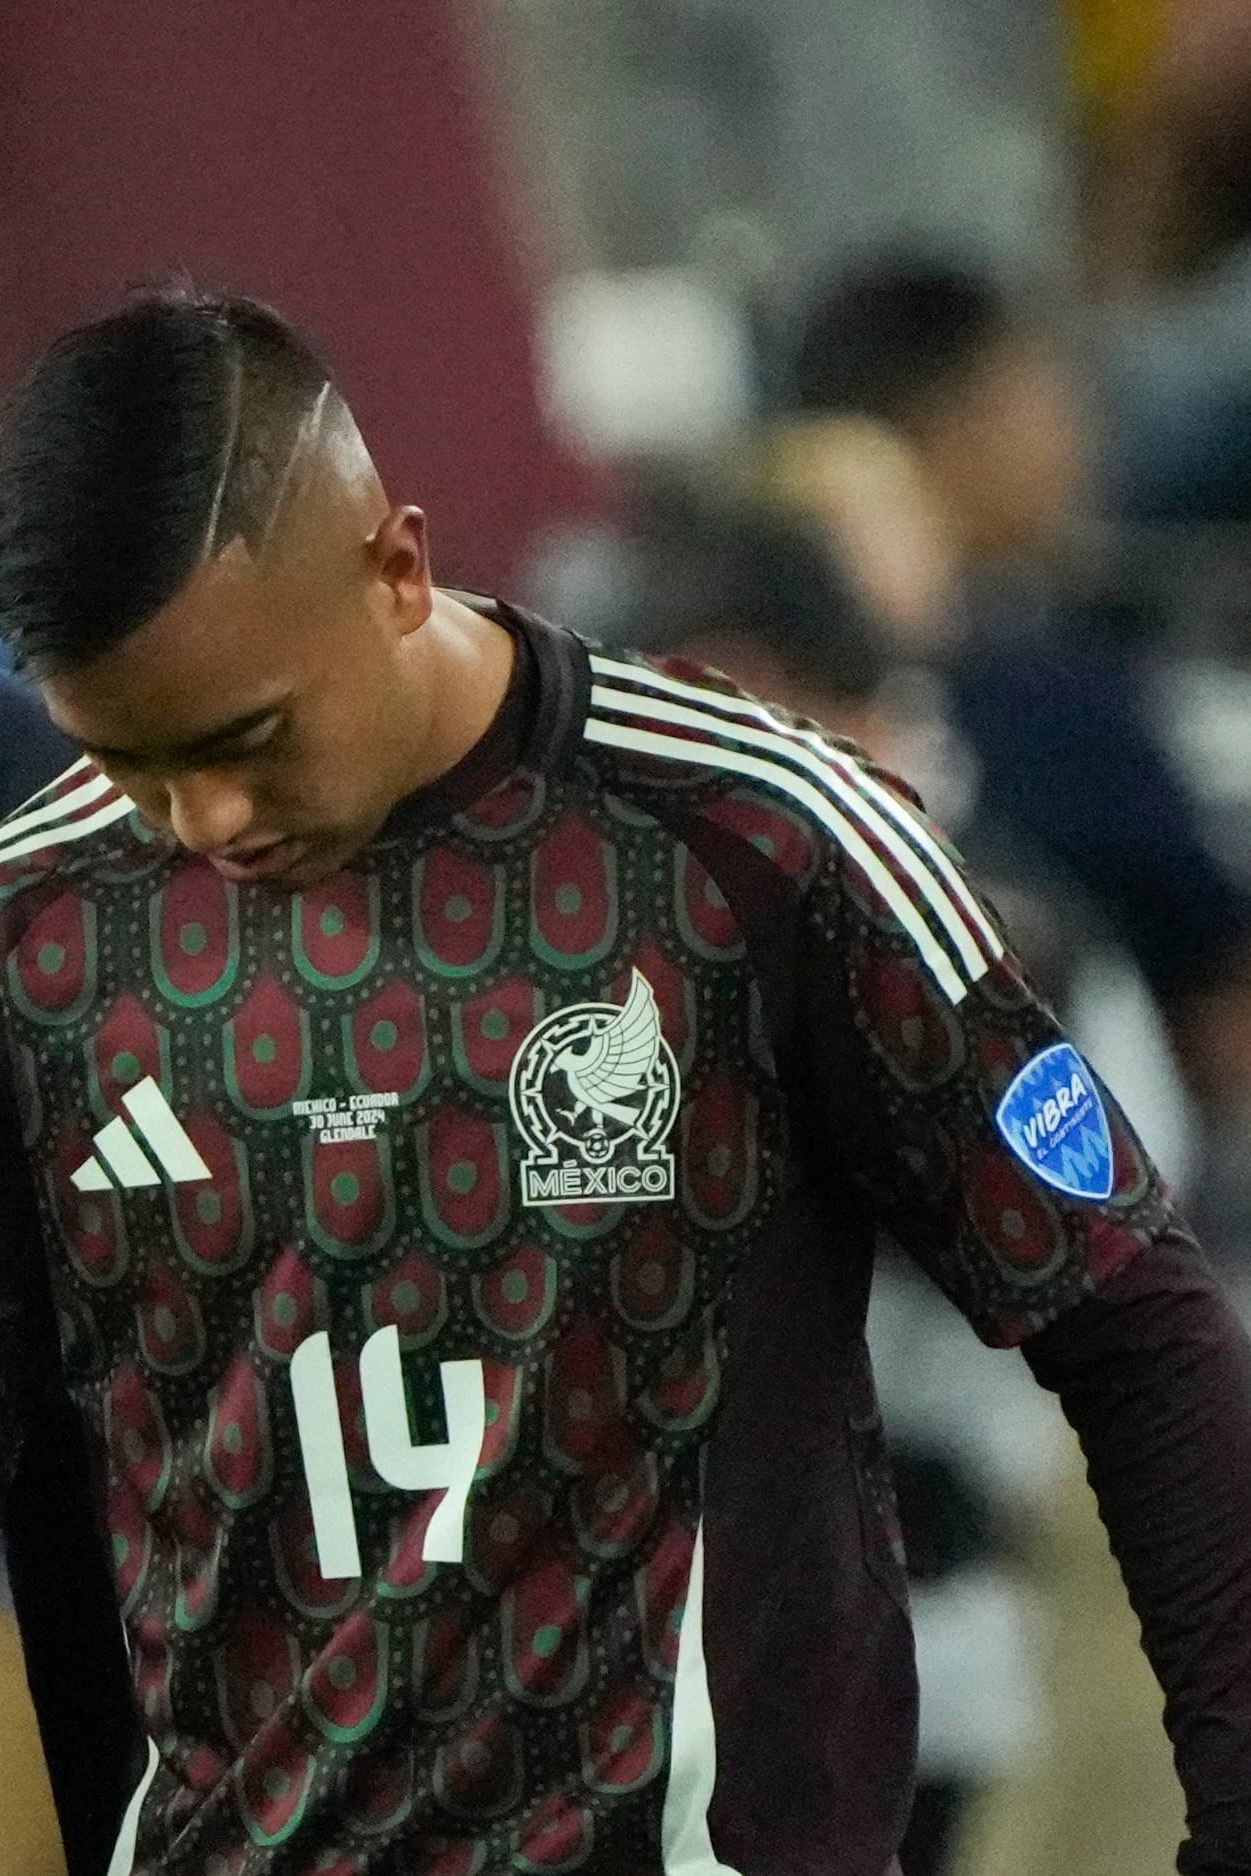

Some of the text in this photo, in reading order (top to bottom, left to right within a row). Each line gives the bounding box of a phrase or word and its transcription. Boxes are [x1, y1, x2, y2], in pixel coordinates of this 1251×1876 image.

[349, 1091, 399, 1111] ECUADOR
[1022, 1072, 1088, 1149] VIBRA
[309, 1108, 386, 1130] 30 JUNE 2024
[319, 1124, 377, 1144] GLENDALE
[528, 1159, 668, 1197] MÉXICO
[289, 1323, 486, 1580] 14
